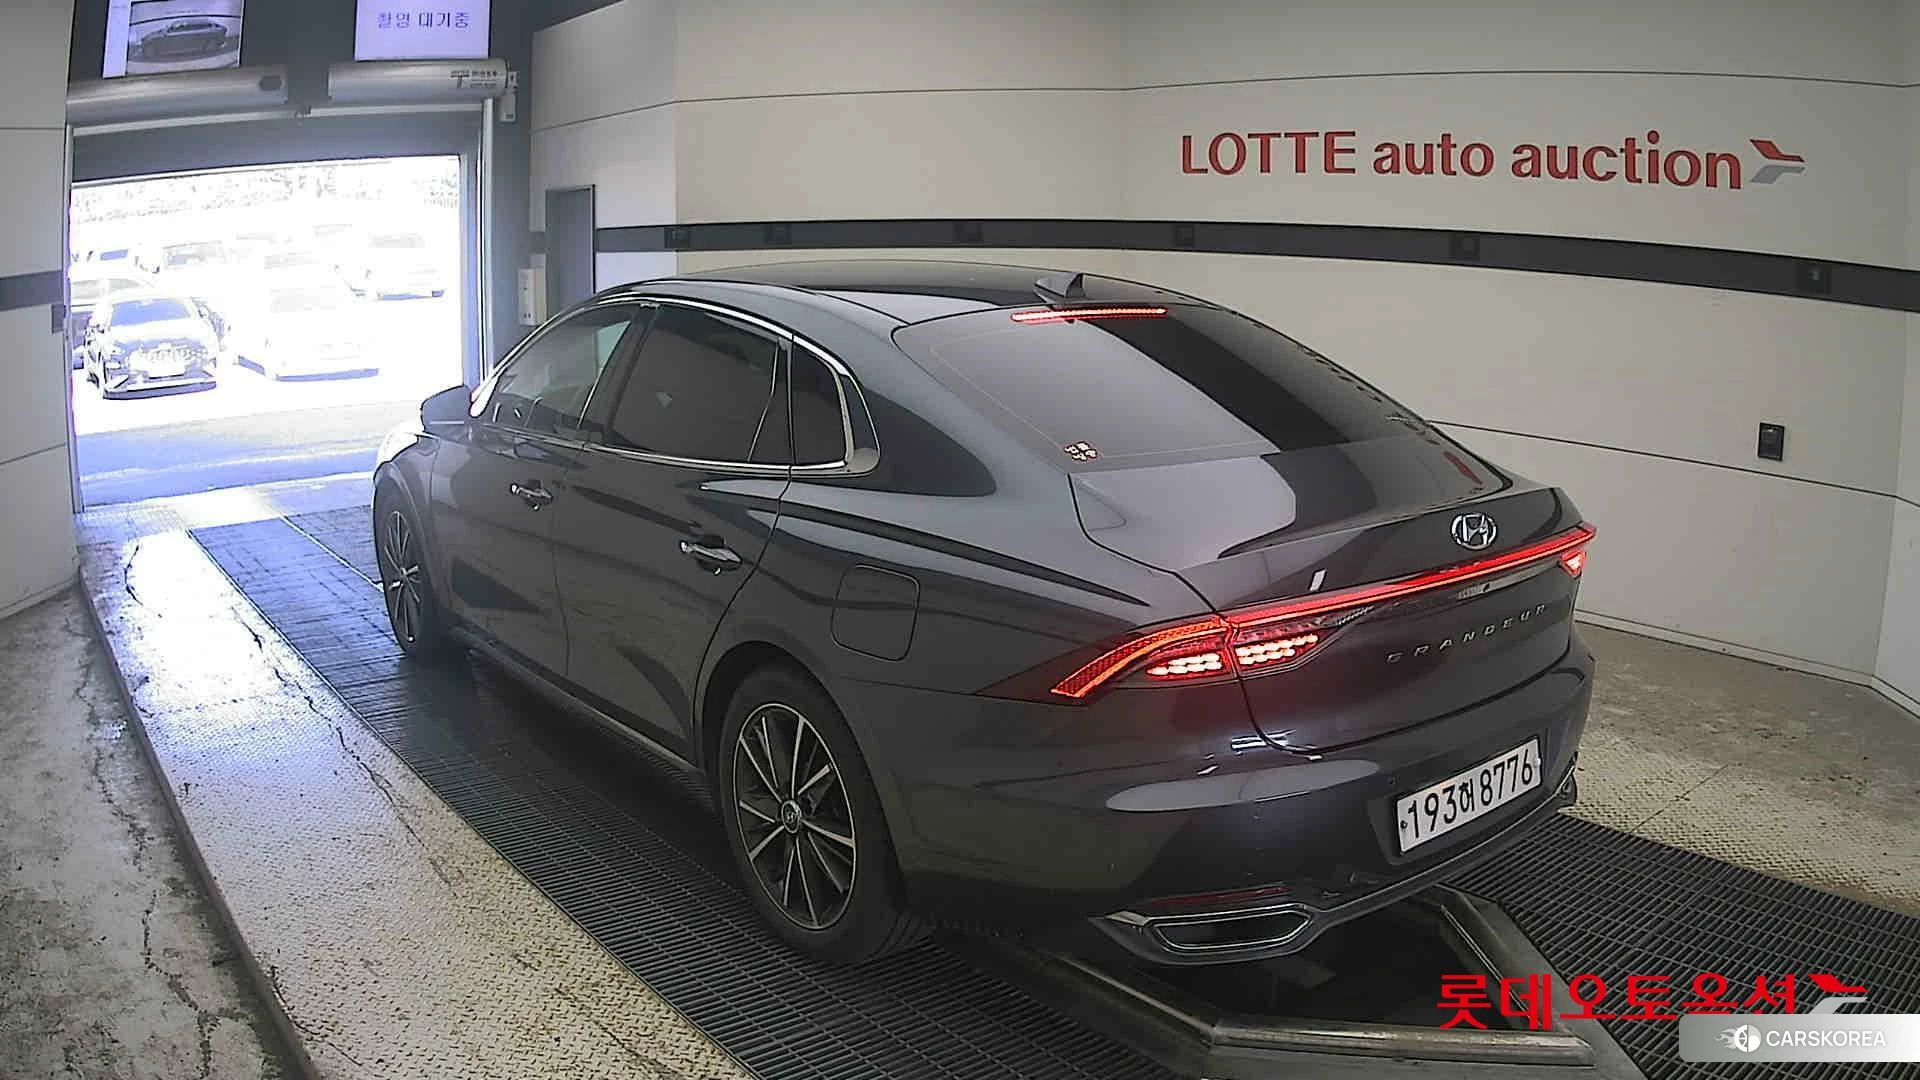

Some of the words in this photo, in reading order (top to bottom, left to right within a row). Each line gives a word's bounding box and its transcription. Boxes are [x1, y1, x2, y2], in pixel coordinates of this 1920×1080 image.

[418, 11, 470, 29] 대기중
[1182, 131, 1357, 175] LOTTE
[1373, 132, 1494, 177] auto
[1511, 131, 1742, 190] auction
[1387, 604, 1545, 664] GRANDEUR
